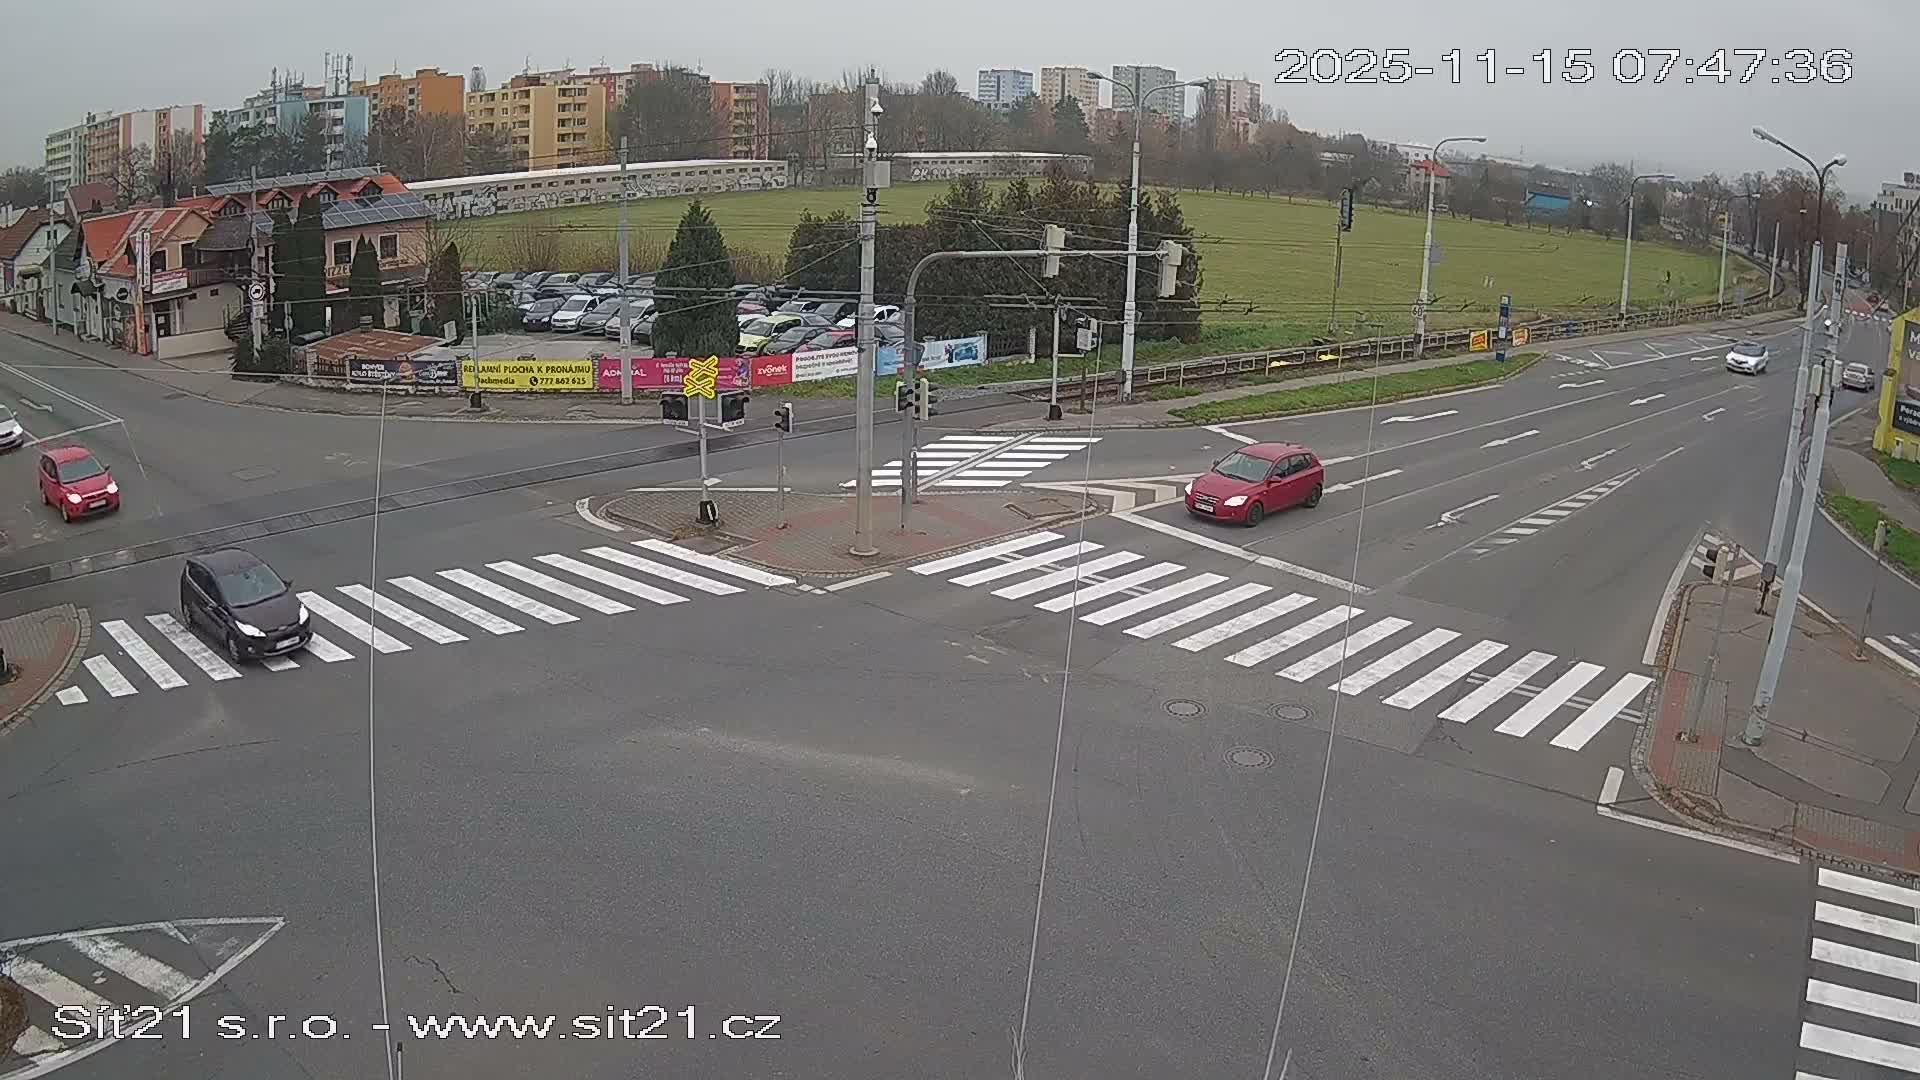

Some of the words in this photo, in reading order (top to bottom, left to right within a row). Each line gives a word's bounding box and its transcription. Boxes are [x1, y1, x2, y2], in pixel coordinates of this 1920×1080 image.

[504, 365, 534, 374] PLOCHA
[537, 365, 543, 373] K
[546, 364, 590, 374] PRONÁJMU
[540, 377, 553, 385] 777
[555, 377, 569, 385] 862
[571, 377, 586, 385] 625
